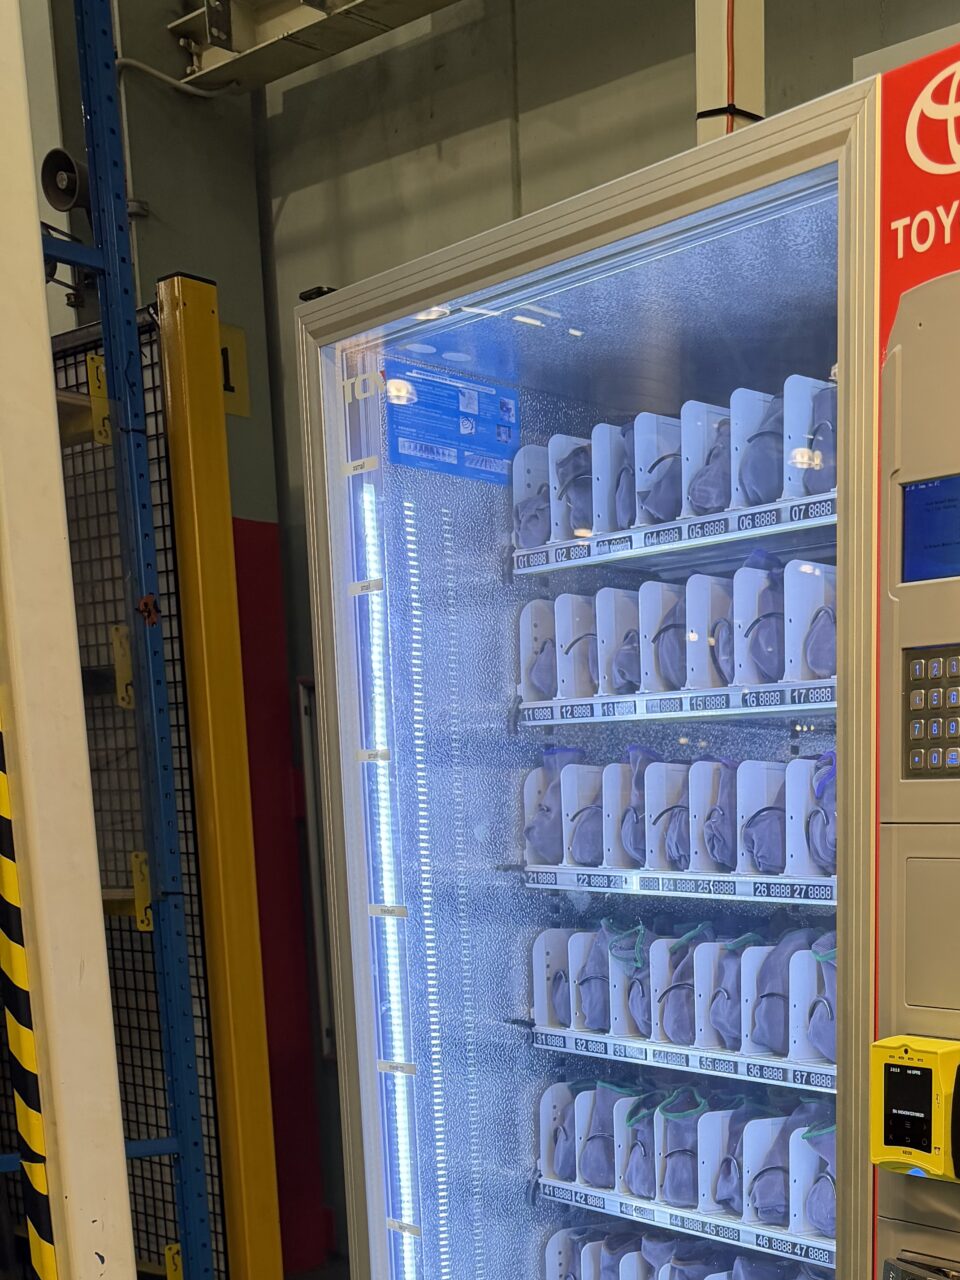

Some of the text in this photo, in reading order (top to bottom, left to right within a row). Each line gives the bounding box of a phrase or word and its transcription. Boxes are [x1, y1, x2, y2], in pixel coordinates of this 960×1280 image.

[792, 502, 831, 520] 07 8888
[740, 512, 776, 529] 06 8888
[690, 521, 724, 538] 05 8888
[646, 529, 679, 546] 04 8888
[556, 549, 566, 561] 02
[519, 556, 527, 568] 01
[916, 665, 919, 675] 1
[933, 663, 938, 675] 2
[952, 661, 956, 672] 3
[745, 692, 780, 706] 16 8888
[793, 688, 831, 703] 17 8888
[603, 703, 613, 715] 13
[692, 696, 725, 710] 15 8888
[524, 709, 533, 720] 11
[562, 706, 571, 718] 12
[915, 724, 919, 735] 7
[950, 722, 955, 733] 9
[933, 753, 937, 763] 0
[529, 872, 536, 883] 21
[578, 875, 587, 886] 22
[664, 879, 673, 890] 24
[698, 881, 734, 894] 25 8888
[755, 884, 790, 897] 26 8888
[794, 885, 831, 899] 27 8888
[537, 1033, 545, 1044] 31
[576, 1039, 586, 1051] 32
[614, 1045, 624, 1056] 33
[701, 1058, 712, 1069] 35
[749, 1065, 783, 1080] 36 8888
[795, 1072, 831, 1087] 37 8888
[544, 1186, 552, 1196] 41
[576, 1193, 585, 1203] 42
[671, 1214, 681, 1226] 44
[704, 1223, 716, 1235] 45
[757, 1235, 791, 1252] 46 8888
[795, 1245, 829, 1262] 47 8888
